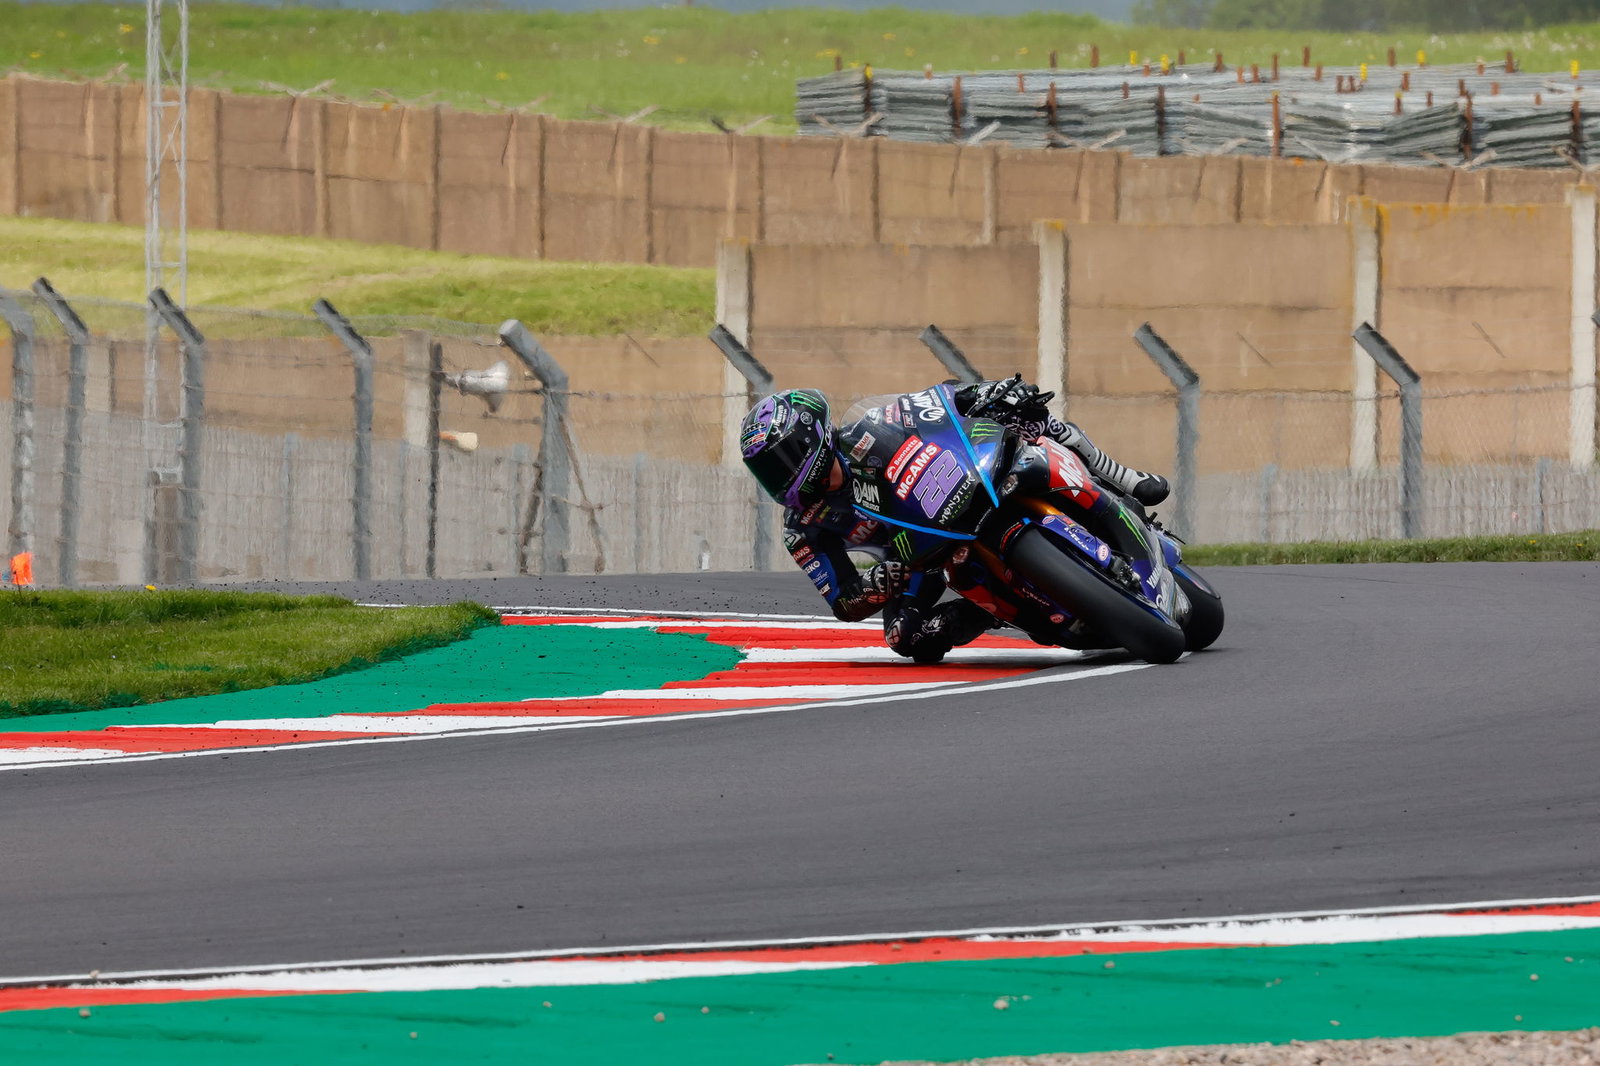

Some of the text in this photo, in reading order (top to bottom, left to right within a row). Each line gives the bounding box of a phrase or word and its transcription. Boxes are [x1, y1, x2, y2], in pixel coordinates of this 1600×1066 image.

[893, 438, 919, 466] Bennetts
[896, 444, 938, 499] McAMS
[912, 450, 965, 519] 22
[938, 474, 976, 525] MONSTER
